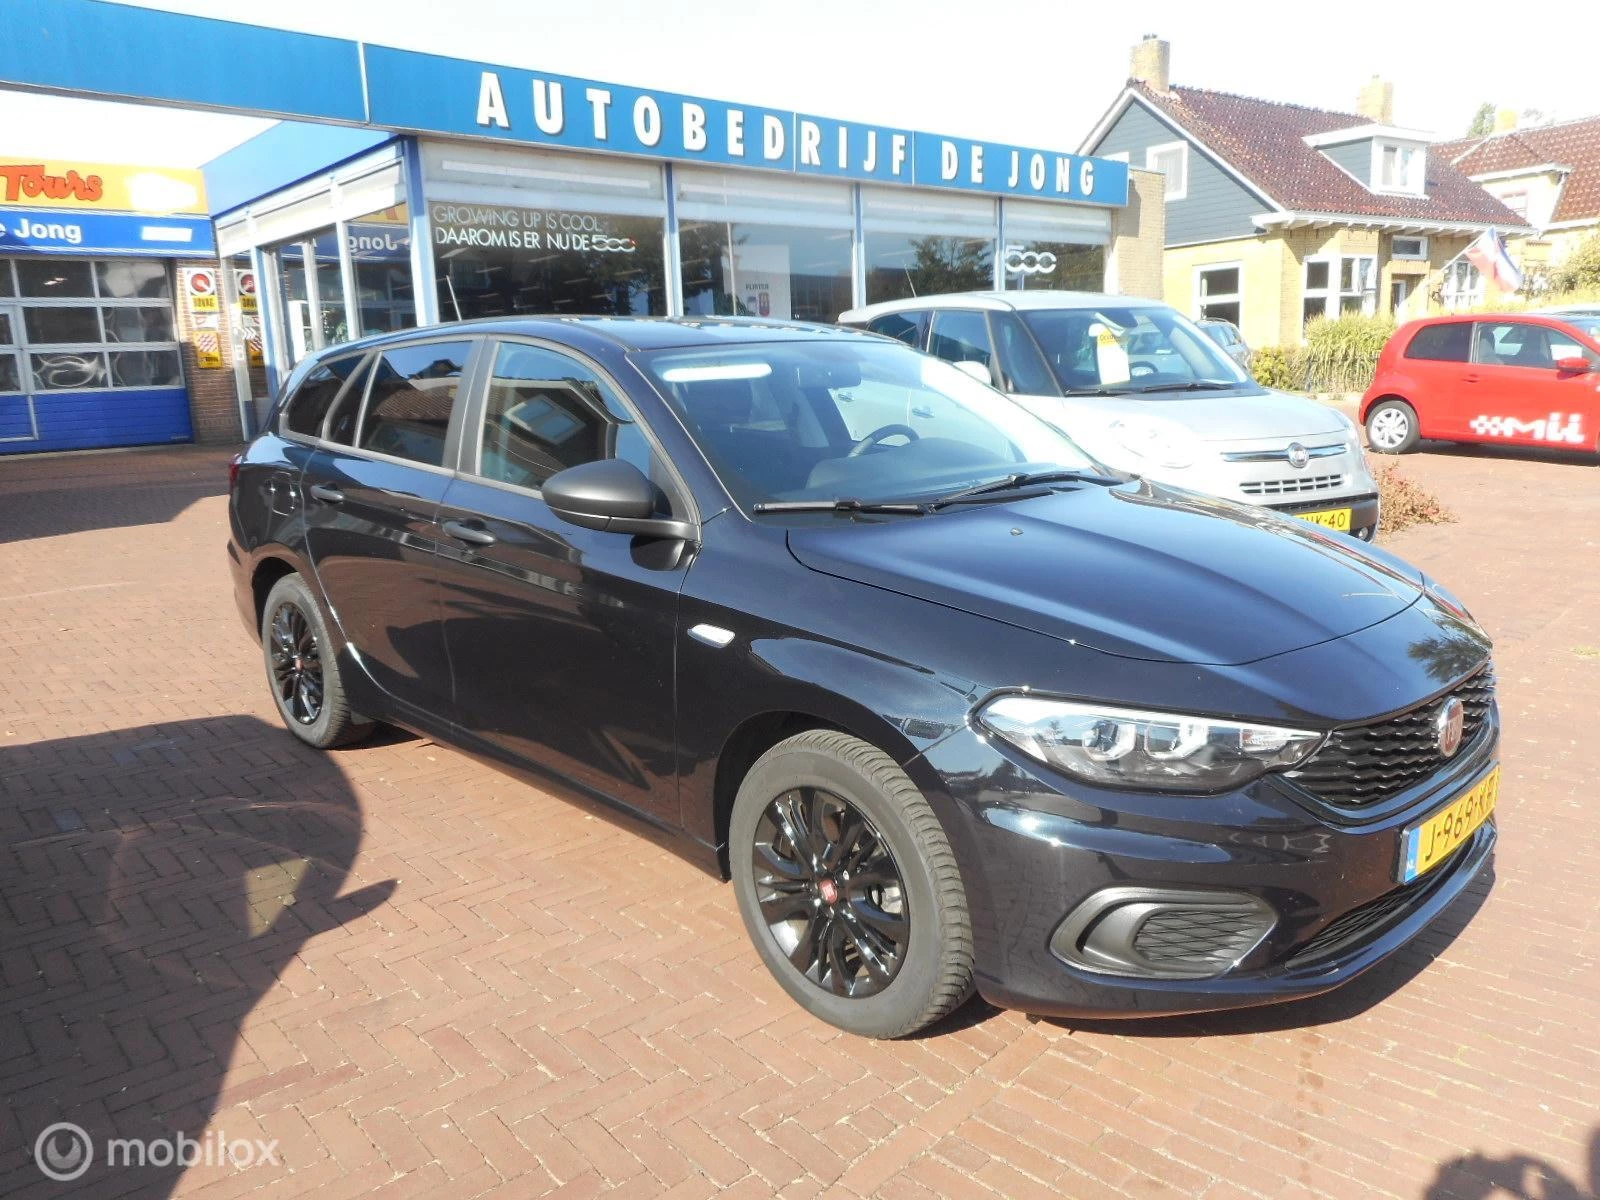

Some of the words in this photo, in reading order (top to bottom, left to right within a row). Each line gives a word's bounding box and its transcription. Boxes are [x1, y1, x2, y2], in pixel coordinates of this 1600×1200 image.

[476, 72, 906, 175] AUTOBEDRIJF
[941, 141, 984, 184] DE
[1008, 151, 1094, 195] JONG
[433, 205, 519, 228] GROWING
[523, 211, 542, 228] UP
[546, 211, 557, 230] IS
[14, 218, 82, 244] Jong
[436, 226, 506, 247] DAAROM
[509, 230, 521, 247] IS
[524, 231, 541, 248] ER
[547, 233, 570, 251] NU
[573, 234, 591, 252] DE
[1005, 245, 1057, 273] 500
